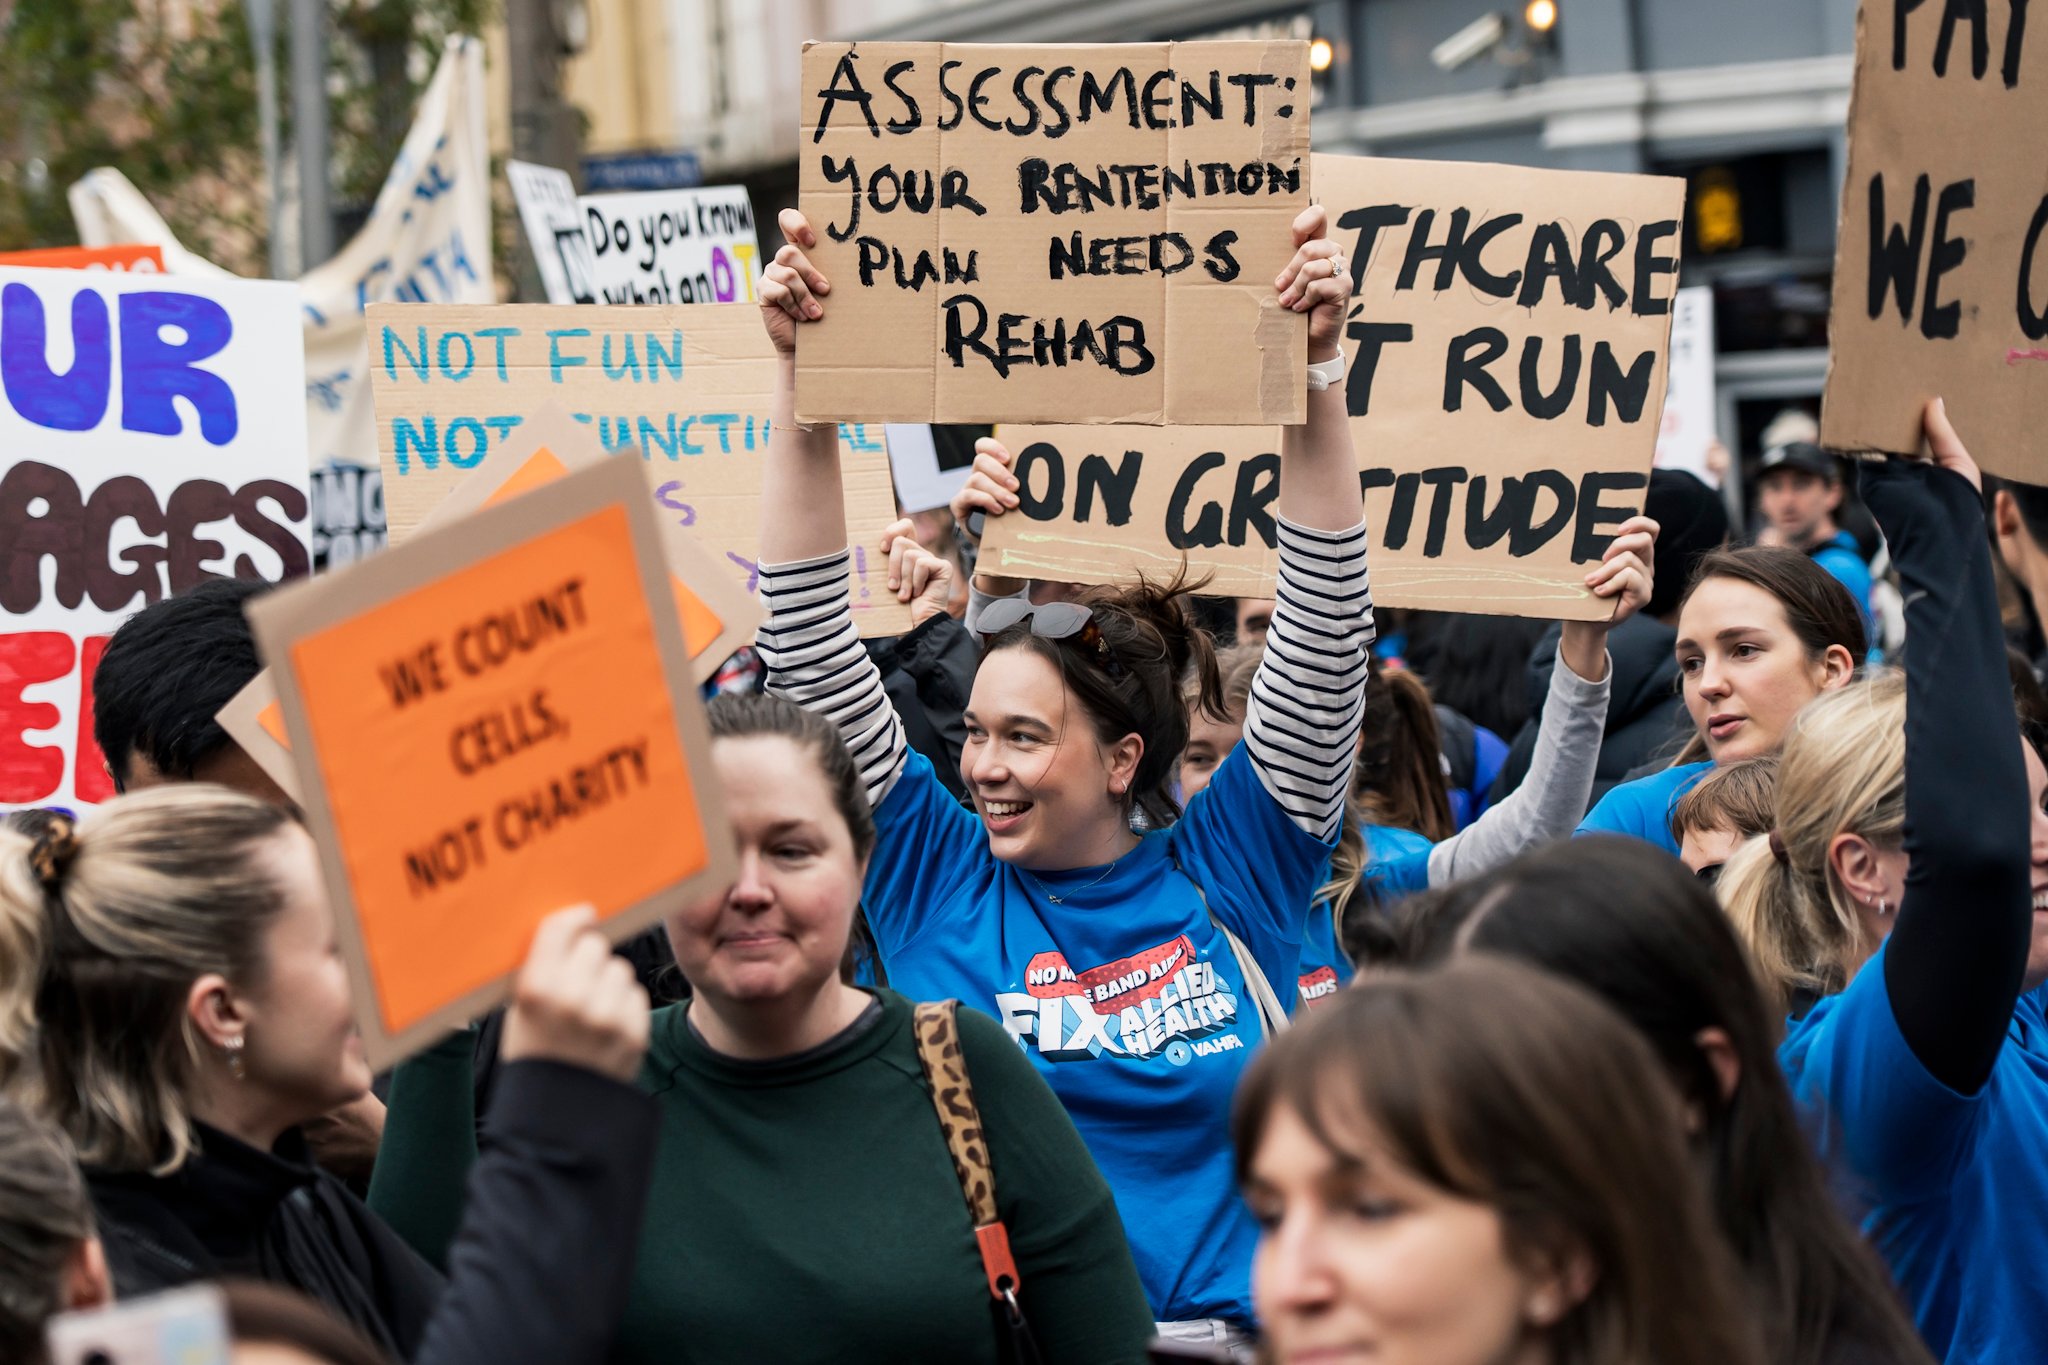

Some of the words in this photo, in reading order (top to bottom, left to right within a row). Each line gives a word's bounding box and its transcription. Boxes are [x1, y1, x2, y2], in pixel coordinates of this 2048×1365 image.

[813, 42, 1297, 144] ASSESSMENT:
[1017, 156, 1300, 215] RENTENTION
[587, 206, 630, 256] Do
[639, 206, 689, 271] you
[692, 196, 754, 238] know
[855, 236, 980, 292] PLAN
[1048, 230, 1241, 283] NEEDS
[1867, 171, 1975, 340] WE
[382, 324, 522, 383] NOT
[546, 327, 684, 383] FUN
[941, 294, 1156, 380] REHAB
[1443, 326, 1656, 427] RUN
[391, 413, 524, 476] NOT
[1012, 442, 1144, 527] ON
[378, 640, 450, 710] WE
[453, 577, 588, 678] COUNT
[449, 688, 571, 778] CELLS,
[404, 815, 487, 900] NOT
[494, 738, 649, 853] CHARITY
[1028, 966, 1058, 985] NO
[1094, 967, 1148, 1002] BAND
[1149, 944, 1183, 981] AIDS
[1119, 961, 1216, 1037] ALLIED
[995, 992, 1124, 1053] FIX
[1121, 991, 1236, 1056] HEALTH
